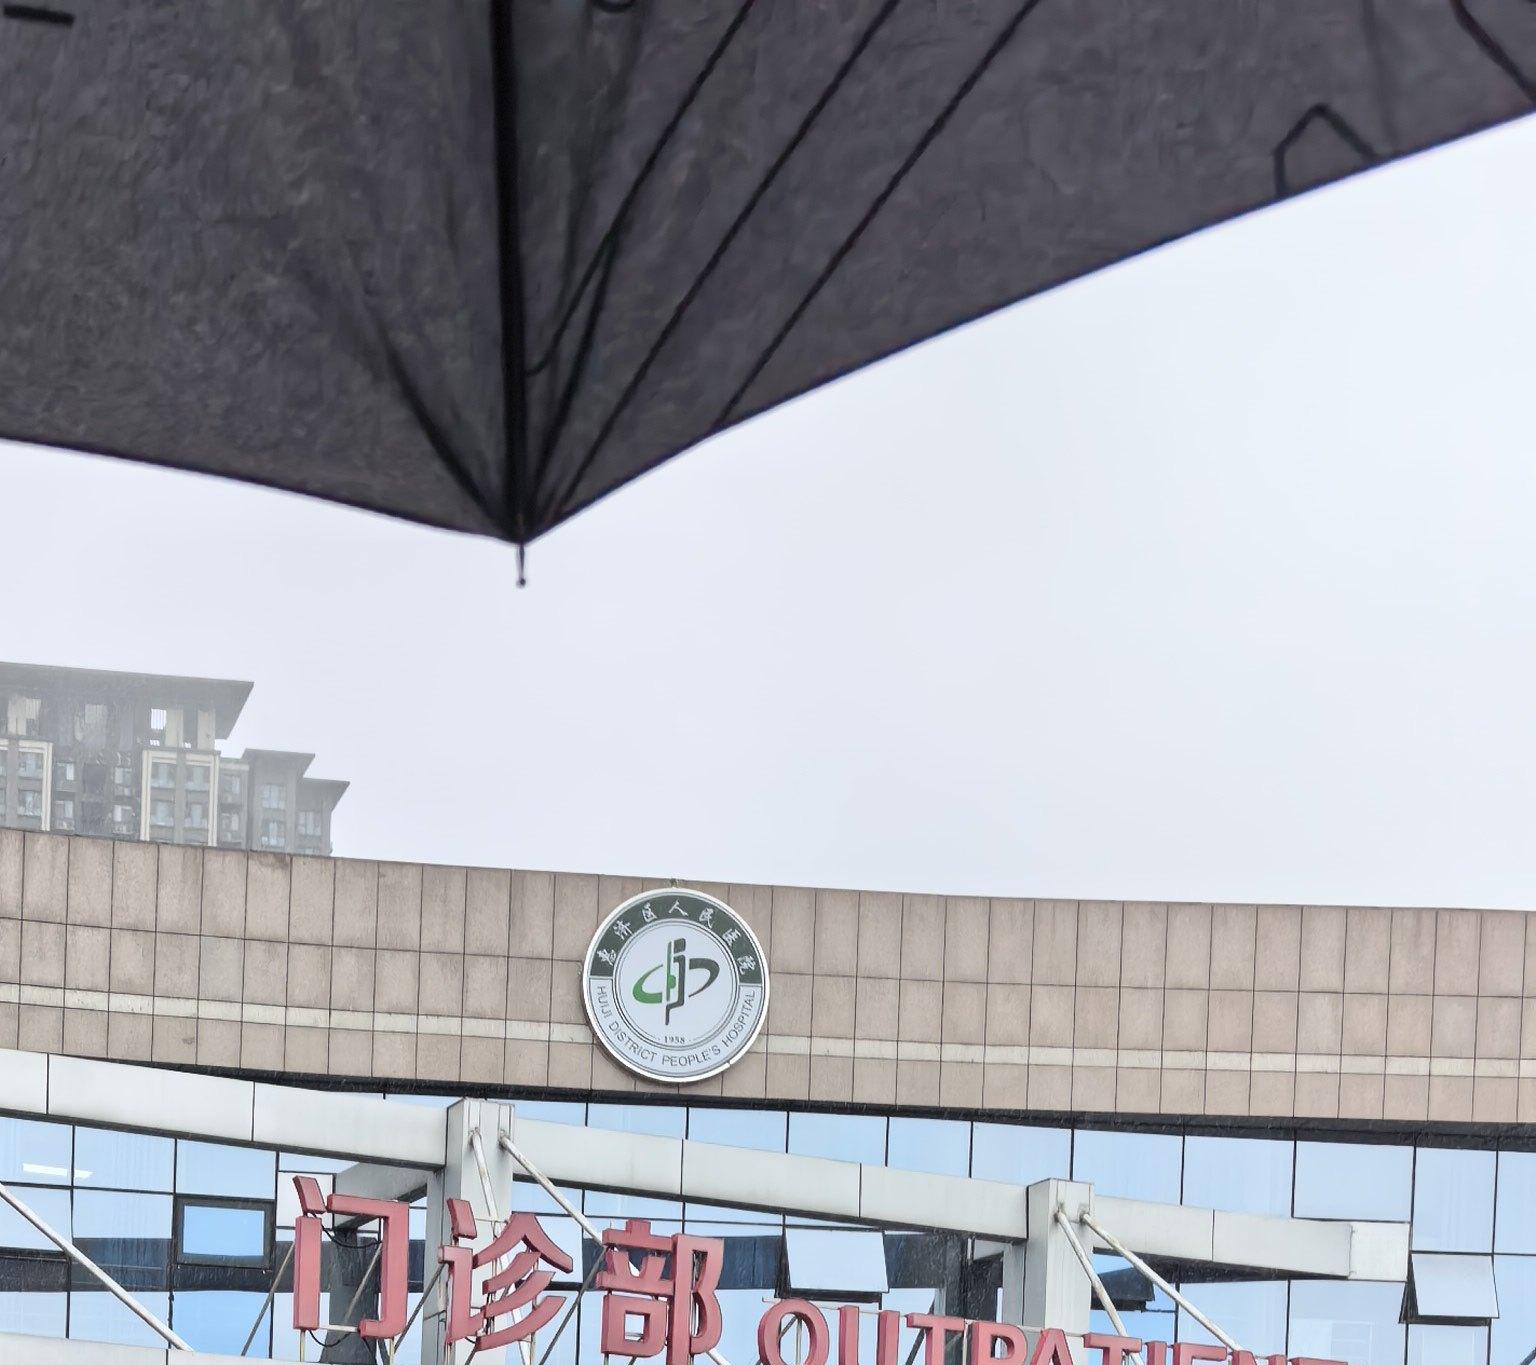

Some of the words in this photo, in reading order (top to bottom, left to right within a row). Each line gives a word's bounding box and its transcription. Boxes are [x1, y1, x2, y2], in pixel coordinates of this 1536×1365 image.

[597, 985, 612, 1016] HUIJI
[608, 1021, 657, 1062] DISTRICT
[662, 1045, 721, 1067] PEOPLE'S
[723, 990, 755, 1047] HOSPITAL
